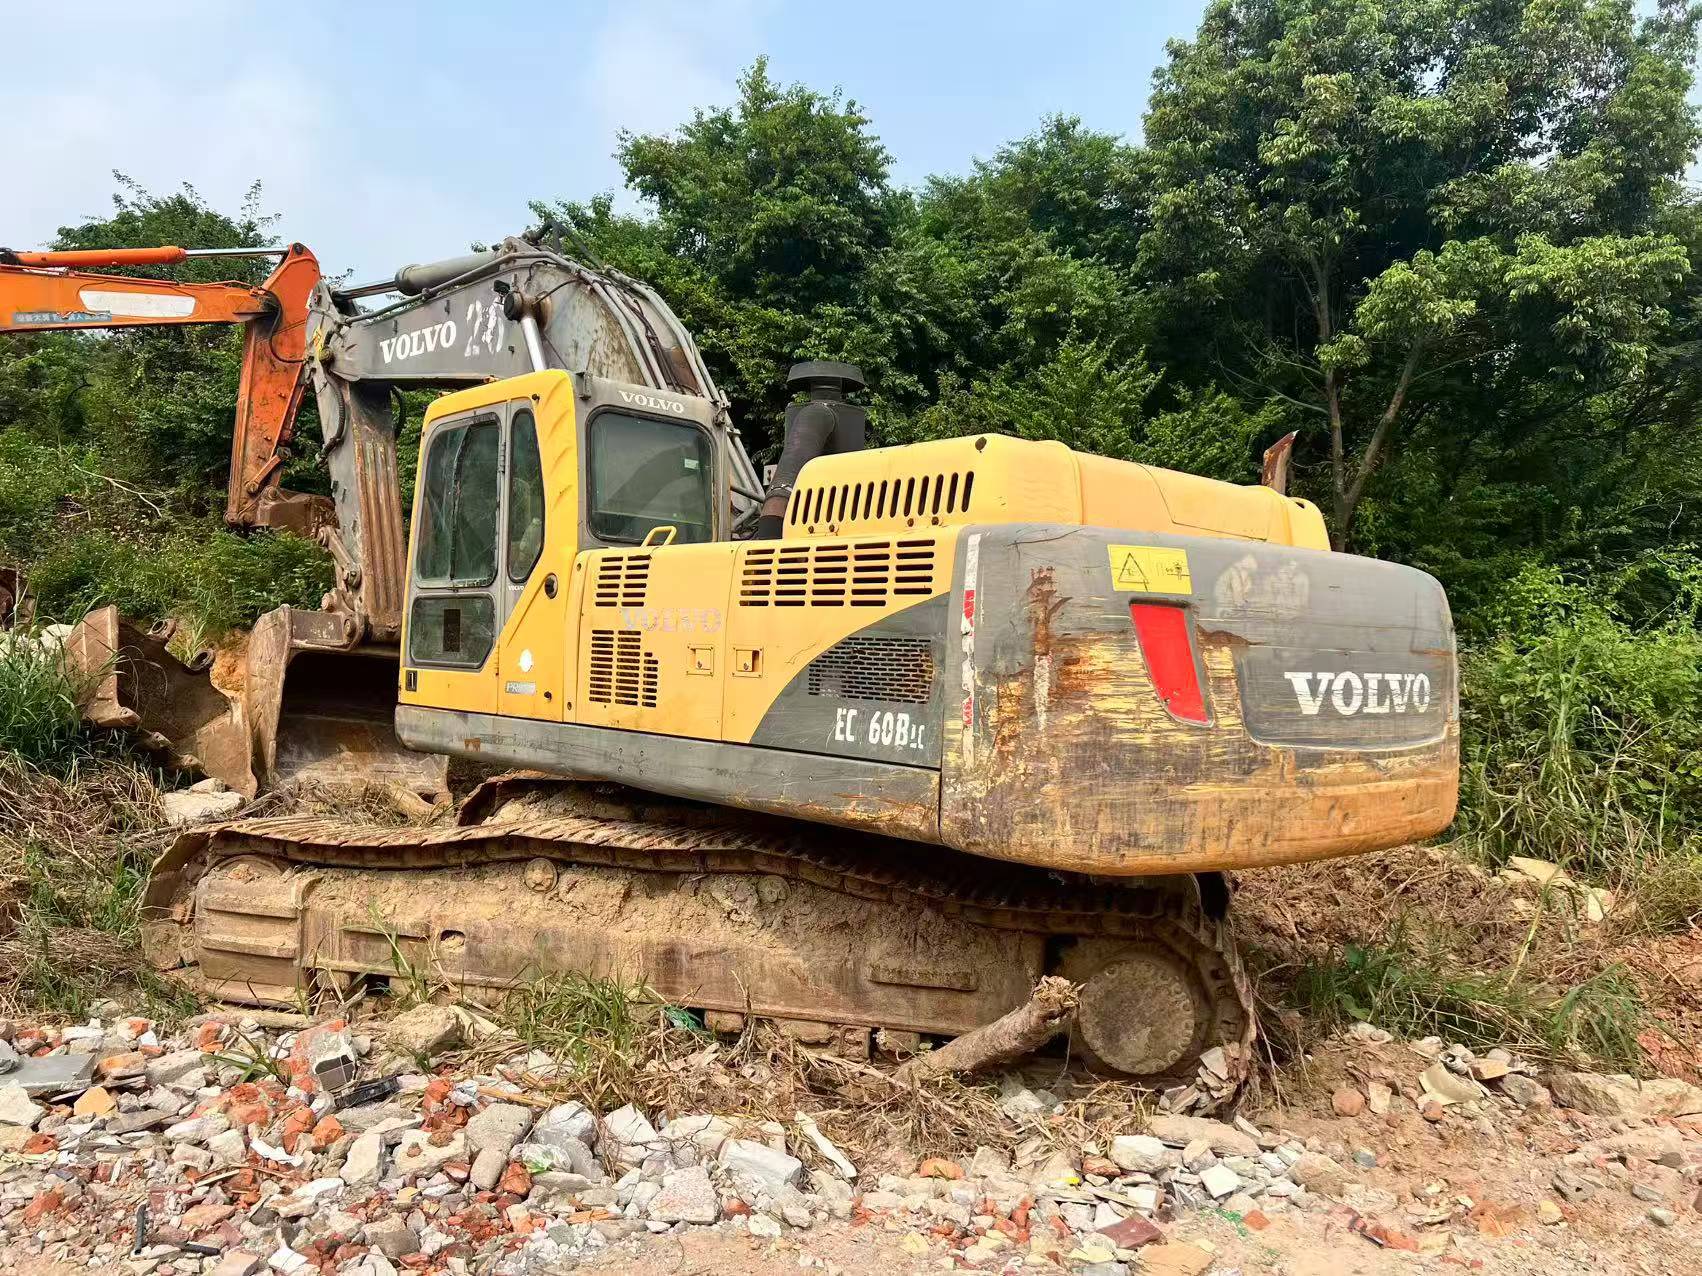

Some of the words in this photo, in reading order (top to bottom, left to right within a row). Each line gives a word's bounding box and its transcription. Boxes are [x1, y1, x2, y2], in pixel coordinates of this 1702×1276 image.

[379, 320, 457, 364] VOLVO
[618, 390, 685, 414] VOLVO
[621, 607, 721, 633] VOLVO
[1283, 670, 1431, 716] VOLVO
